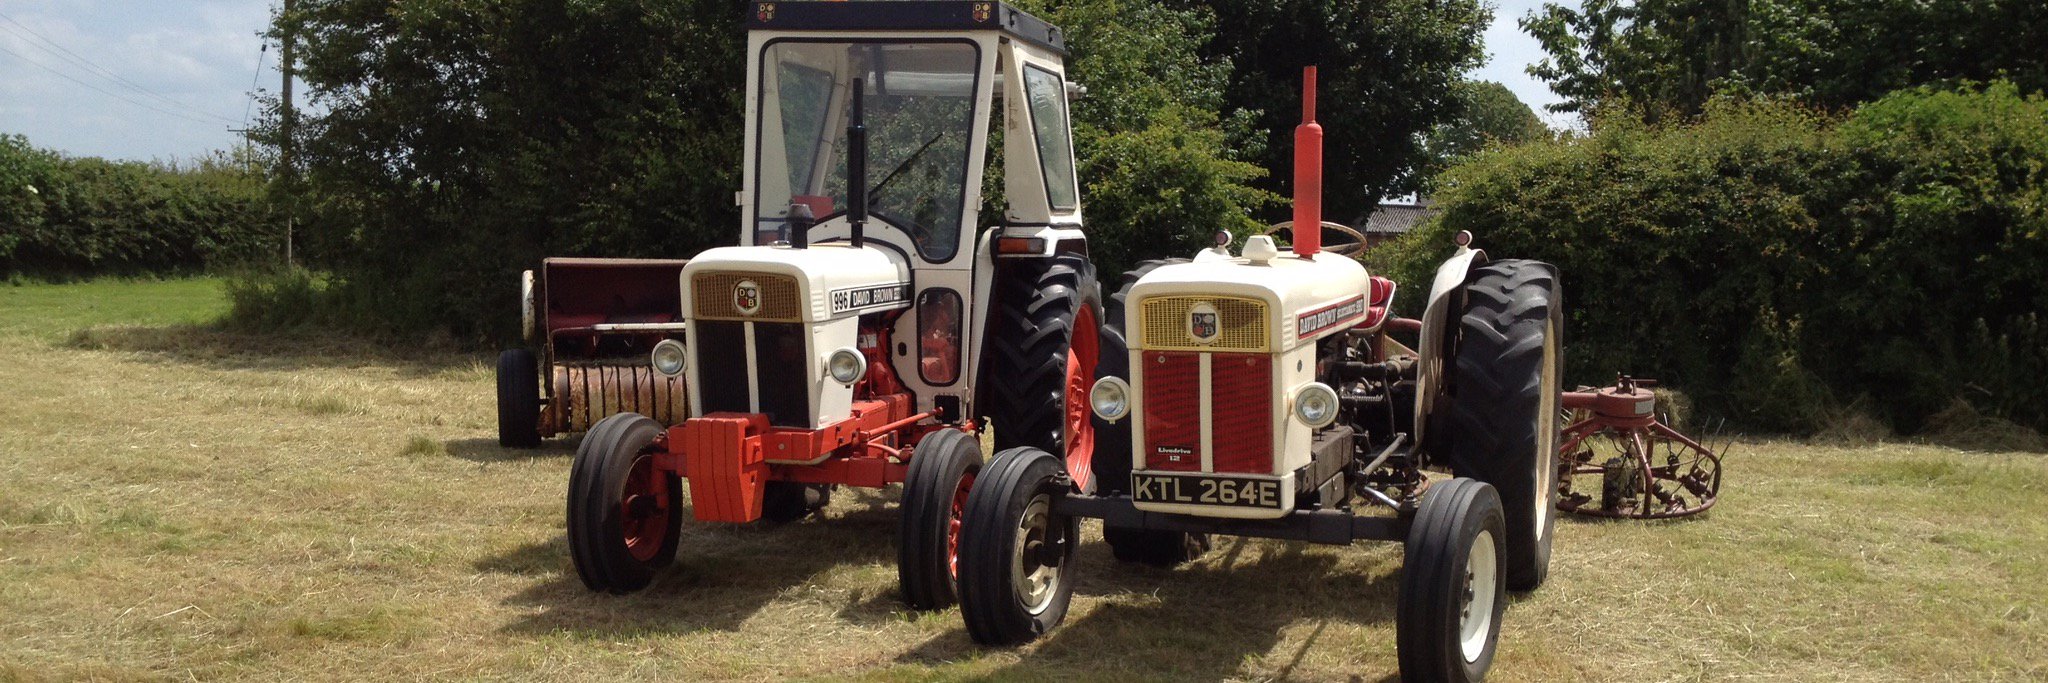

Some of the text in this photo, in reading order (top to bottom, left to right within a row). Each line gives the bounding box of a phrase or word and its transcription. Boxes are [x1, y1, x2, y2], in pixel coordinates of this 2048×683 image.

[739, 288, 746, 297] D
[747, 298, 754, 307] B
[834, 291, 848, 311] 996
[852, 290, 870, 307] DAVID
[873, 287, 894, 304] BROWN
[1193, 315, 1202, 324] D
[1299, 314, 1317, 335] DAVID
[1317, 307, 1337, 329] BROWN
[1205, 326, 1214, 335] B
[1158, 446, 1192, 455] Livedrive
[1135, 476, 1278, 506] KTL 264E
